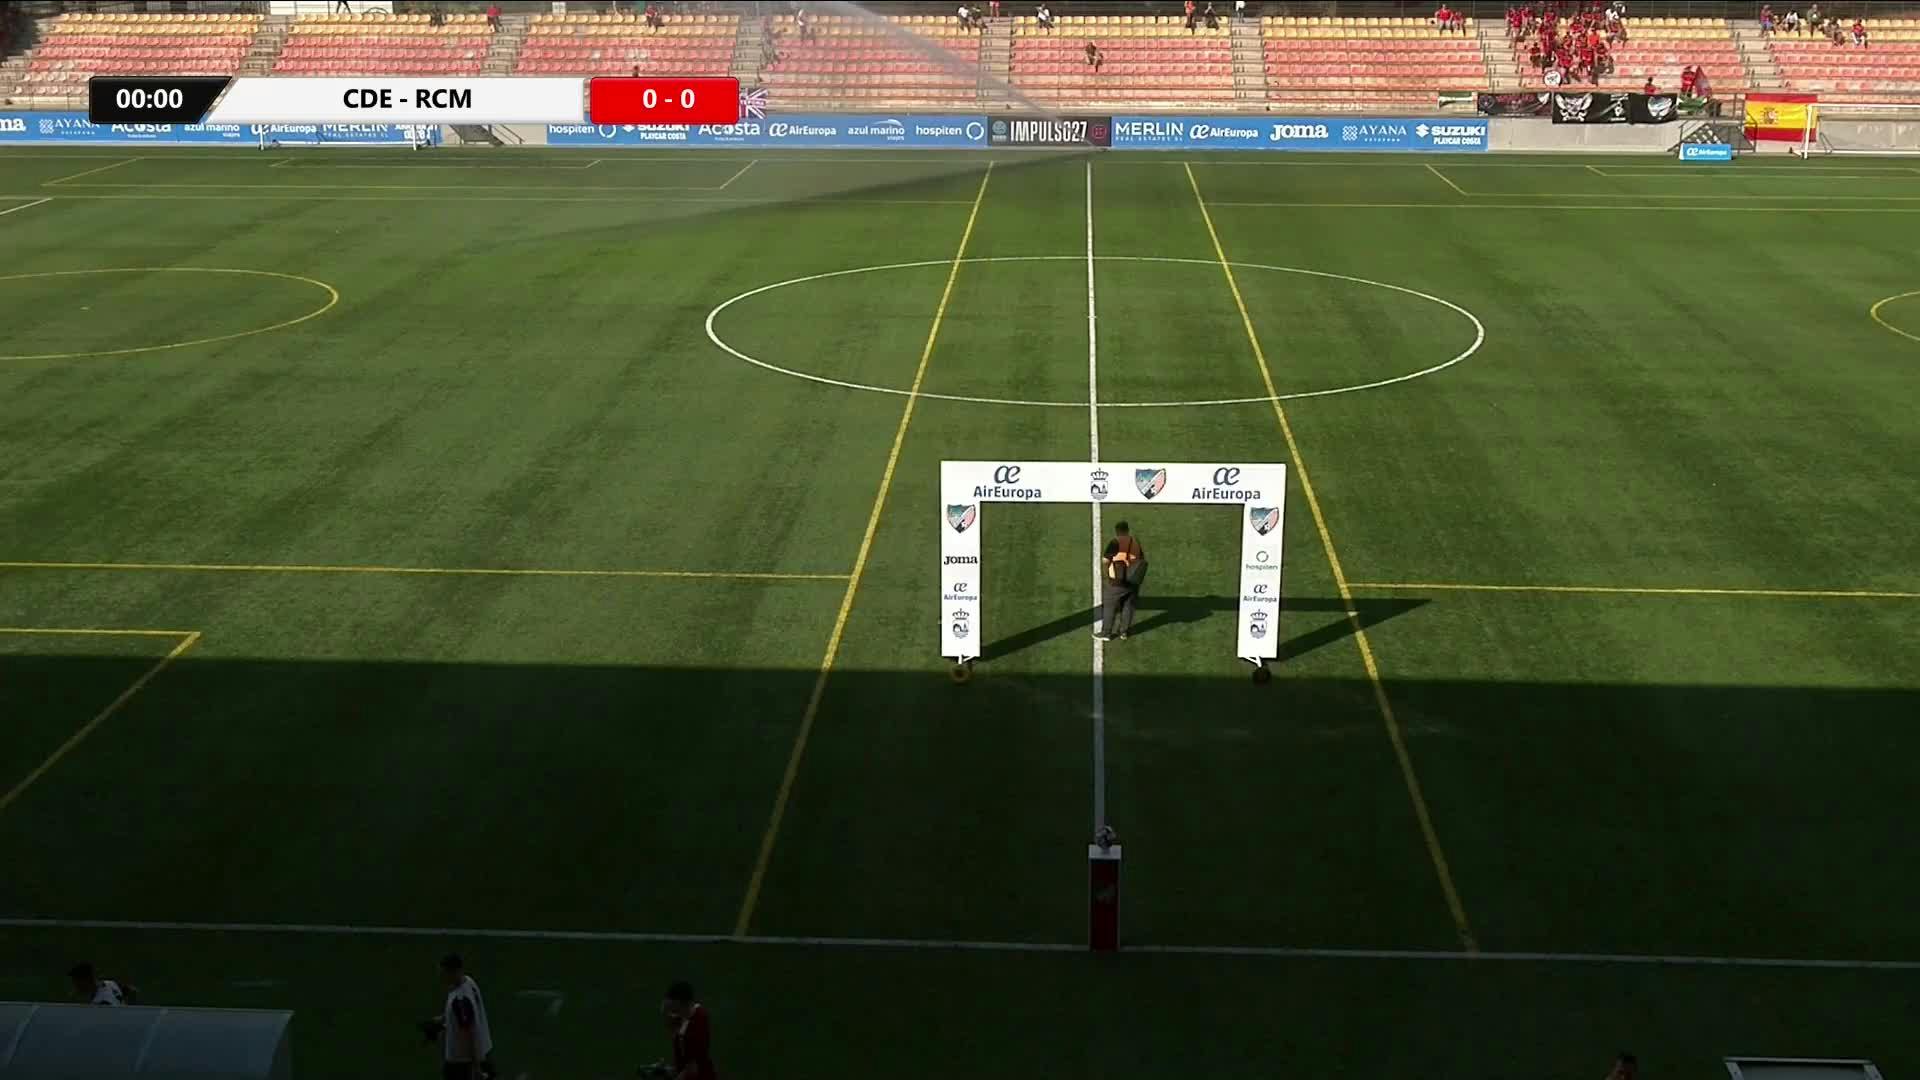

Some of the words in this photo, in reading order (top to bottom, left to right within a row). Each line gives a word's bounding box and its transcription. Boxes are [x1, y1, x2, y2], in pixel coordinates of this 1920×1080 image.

[789, 126, 837, 136] AirEuropa
[848, 126, 868, 135] azul
[870, 125, 905, 135] marino
[915, 125, 962, 136] hospiten
[1010, 121, 1088, 142] IMPULSO27
[1115, 122, 1184, 136] MERLIN
[1210, 127, 1259, 139] AirEuropa
[1270, 124, 1328, 141] Joma
[1359, 125, 1407, 136] AYANA
[1431, 126, 1485, 136] SUZUKI
[973, 485, 1042, 500] AirEuropa
[1192, 487, 1261, 502] AirEuropa
